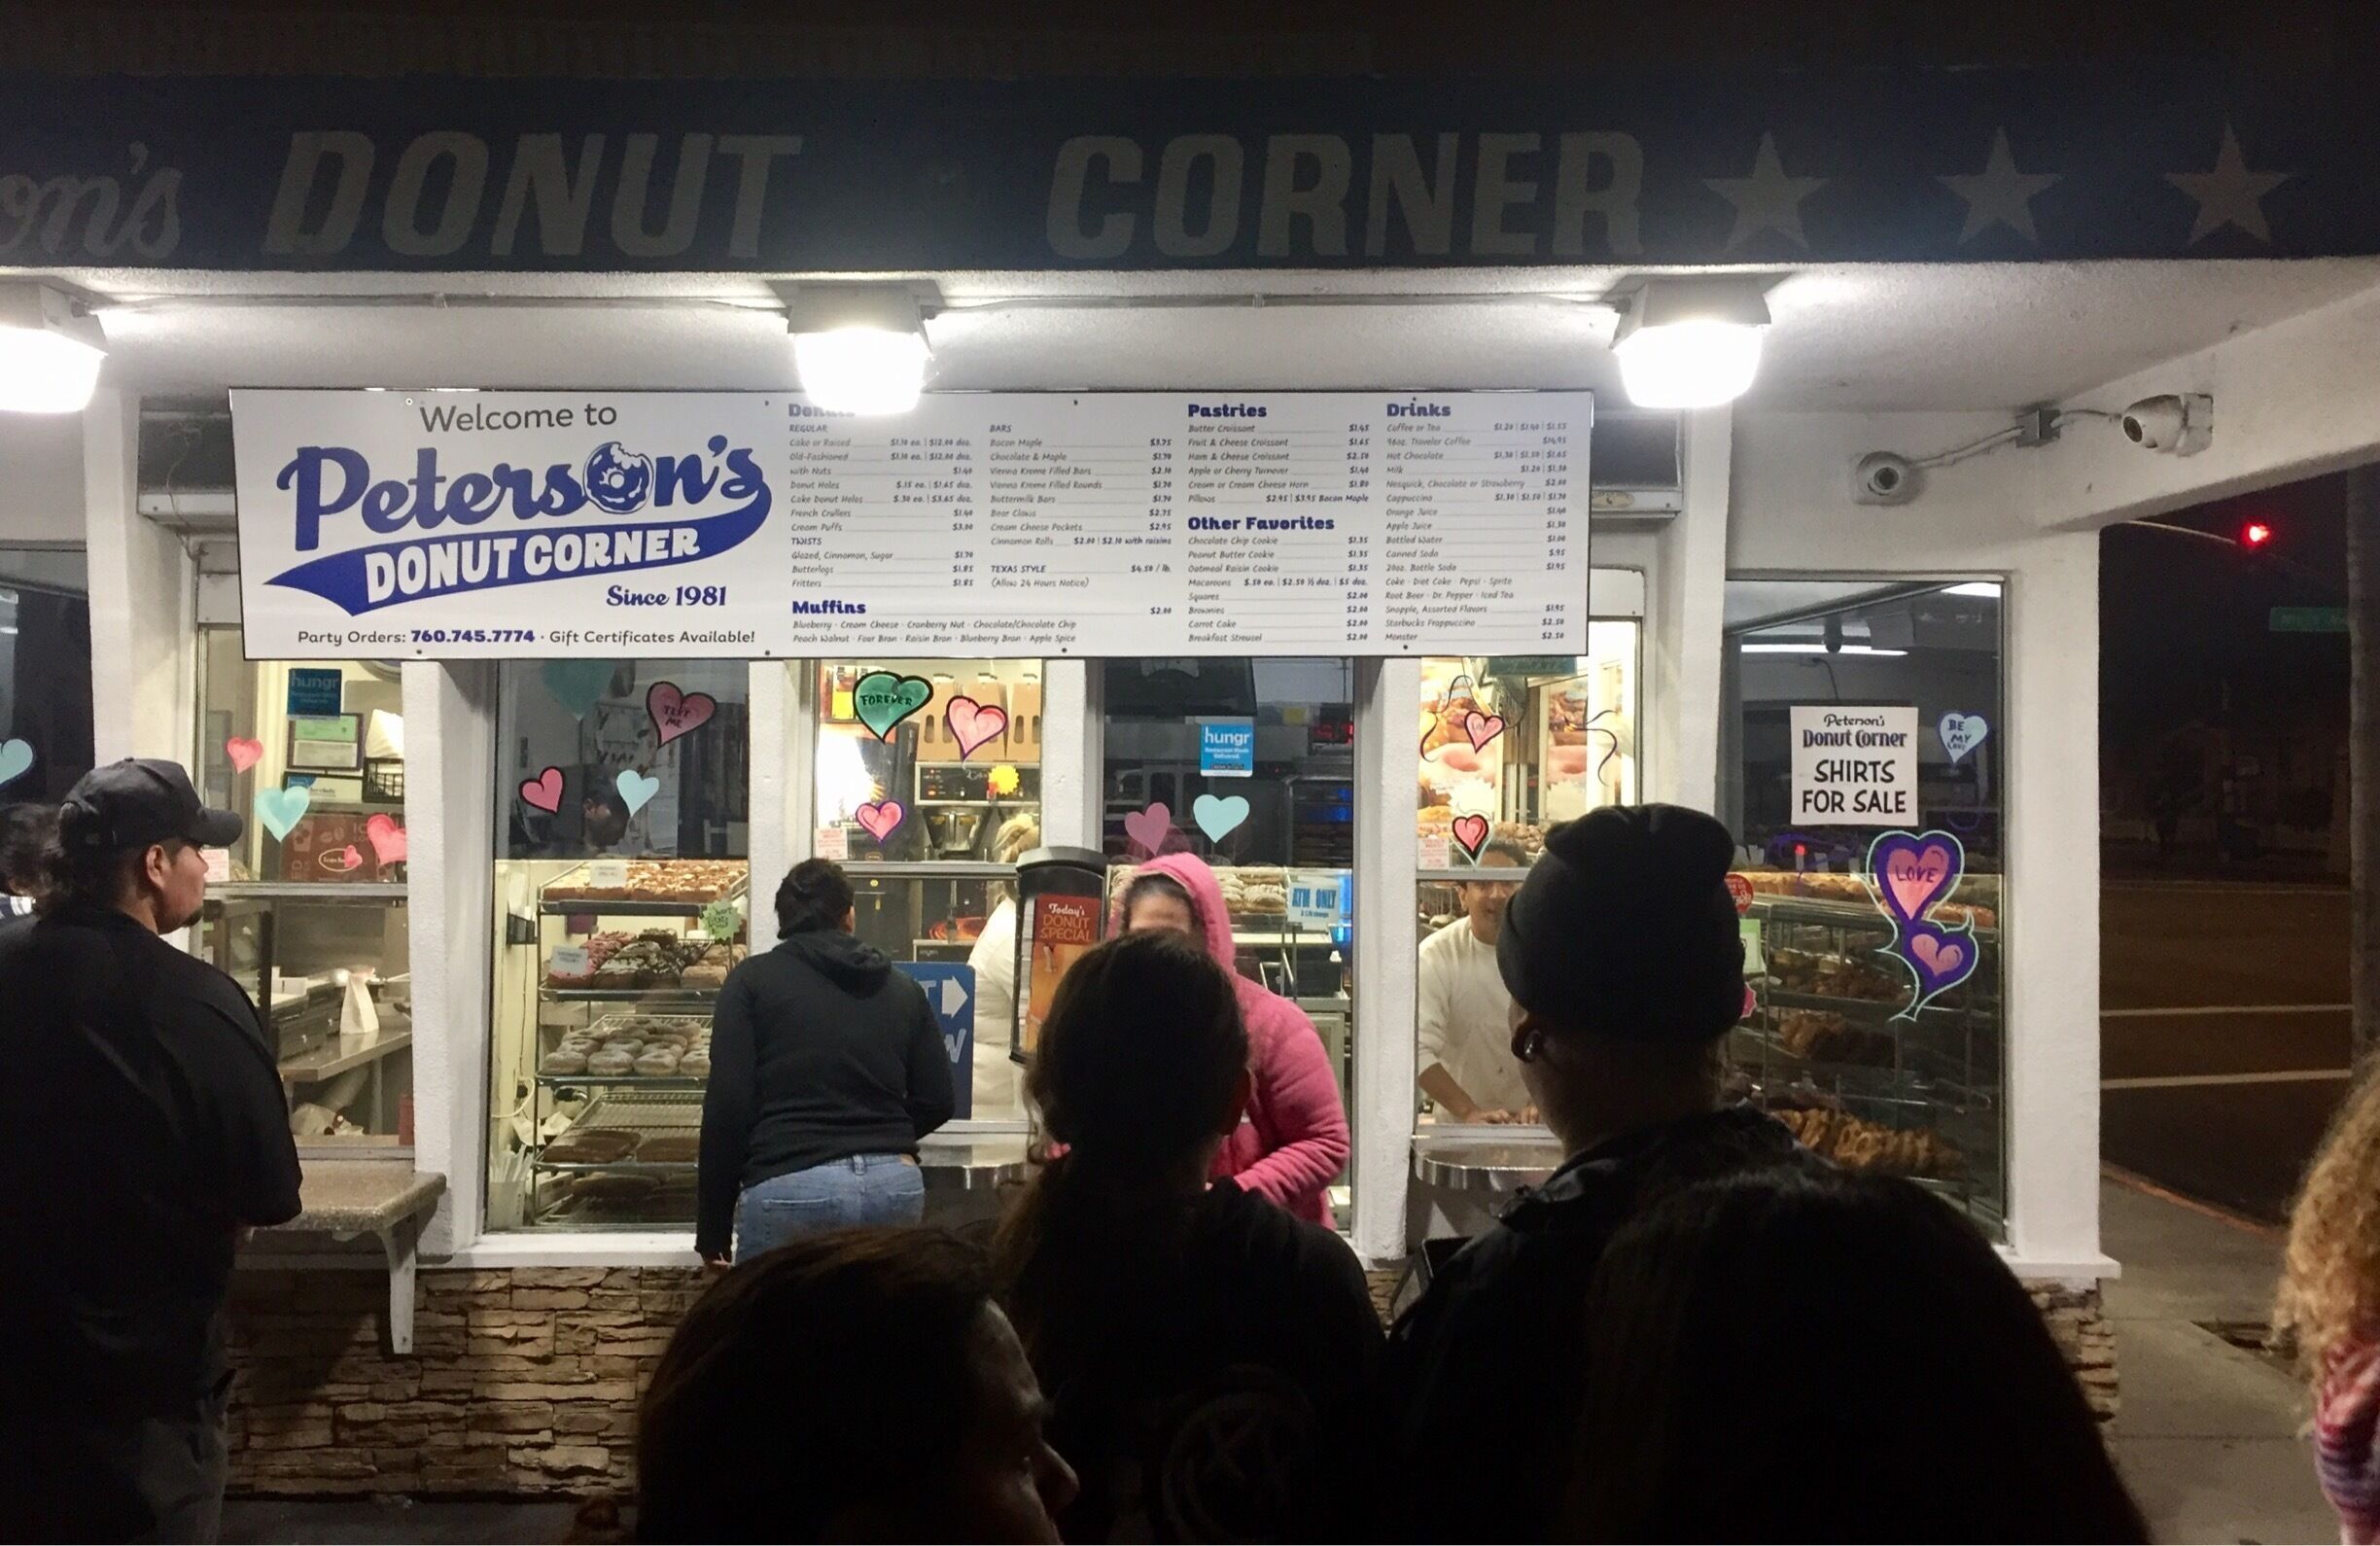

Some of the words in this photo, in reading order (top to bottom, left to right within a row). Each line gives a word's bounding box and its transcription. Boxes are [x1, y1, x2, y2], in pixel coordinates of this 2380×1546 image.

[265, 130, 802, 258] DONUT
[1046, 131, 1645, 259] CORNER
[1188, 404, 1267, 417] Pastries
[1387, 403, 1451, 417] Drinks
[419, 404, 574, 433] Welcome
[584, 404, 617, 426] to
[789, 424, 827, 433] REGULAR
[990, 424, 1011, 433] BARS
[1217, 422, 1255, 433] Croissant
[1386, 422, 1414, 433] Coffee
[1427, 423, 1441, 432] Tea
[1219, 438, 1248, 447] Cheese
[1410, 437, 1442, 446] Traveler
[1444, 436, 1471, 446] Coffee
[1188, 452, 1208, 461] Ham
[1220, 451, 1249, 461] Cheese
[1252, 452, 1289, 461] Croissant
[1403, 450, 1444, 460] Chocolate
[1188, 466, 1211, 476] Apple
[1225, 466, 1252, 477] Cherry
[1386, 466, 1403, 474] Milk
[1188, 480, 1214, 489] Cream
[1229, 480, 1255, 489] Cream
[1258, 479, 1286, 489] Cheese
[1386, 494, 1433, 504] Cappuccino
[790, 509, 818, 517] French
[822, 509, 851, 517] Crullers
[1385, 509, 1415, 518] Orange
[1417, 508, 1438, 516] Juice
[821, 522, 842, 532] Puffs
[1020, 522, 1049, 531] Cheese
[1188, 517, 1241, 530] Other
[1246, 516, 1334, 530] Favorites
[1386, 521, 1409, 532] Apple
[1188, 536, 1228, 545] Chocolate
[1231, 536, 1249, 546] Chip
[1252, 536, 1278, 545] Cookie
[1385, 535, 1417, 545] Bottled
[1418, 536, 1443, 545] Water
[791, 551, 821, 561] Glazed,
[823, 551, 867, 561] Cinnamon,
[870, 552, 892, 562] Sugar
[1188, 550, 1216, 559] Peanut
[1219, 550, 1245, 559] Butter
[1248, 549, 1275, 559] Cookie
[1385, 549, 1418, 558] Canned
[1419, 548, 1438, 558] Soda
[365, 538, 517, 604] DONUT
[524, 527, 700, 576] CORNER
[791, 564, 833, 576] Butterlogs
[1188, 564, 1223, 573] Oatmeal
[1225, 564, 1249, 573] Raisin
[1252, 564, 1278, 573] Cookie
[1410, 562, 1435, 572] Bottle
[1437, 563, 1456, 572] Soda
[991, 577, 1017, 588] (Allow
[1020, 579, 1031, 588] 24
[1059, 577, 1089, 588] Notice)
[1188, 579, 1231, 587] Macaroons
[1385, 577, 1405, 586] Coke
[1432, 577, 1452, 585] Coke
[1459, 578, 1481, 587] Pepsi
[1488, 577, 1512, 587] Sprite
[607, 584, 670, 607] Since
[676, 585, 727, 607] 1981
[1188, 592, 1219, 603] Squares
[1446, 591, 1473, 601] Pepper
[792, 600, 866, 614] Muffins
[1385, 605, 1418, 615] Snapple,
[793, 620, 832, 631] Blueberry
[840, 620, 866, 629] Cream
[870, 620, 899, 629] Cheese
[907, 619, 947, 631] Cranberry
[973, 619, 1055, 629] Chocolate/Chocolate
[1058, 619, 1076, 630] Chip
[1216, 619, 1237, 628] Cake
[1385, 617, 1424, 627] Starbucks
[1427, 618, 1475, 628] Frappuccino
[298, 630, 342, 647] Party
[347, 630, 406, 644] Orders:
[410, 630, 535, 643] 760.745.7774
[549, 630, 579, 646] Gift
[589, 630, 675, 646] Certificates
[680, 630, 755, 643] Available!
[793, 634, 818, 643] Peach
[821, 634, 850, 643] Walnut
[905, 634, 929, 643] Raisin
[932, 634, 952, 643] Bran
[960, 634, 998, 645] Blueberry
[1030, 634, 1052, 645] Apple
[1055, 634, 1076, 644] Spice
[1188, 633, 1227, 642] Breakfast
[1230, 633, 1262, 642] Streusel
[859, 694, 913, 706] FOREVER
[665, 717, 682, 728] ME
[1824, 714, 1885, 727] Peterson's
[1947, 720, 1965, 731] BE
[1205, 725, 1251, 747] hungr
[1802, 729, 1852, 748] Donut
[1855, 730, 1908, 749] Corner
[1951, 734, 1972, 744] MY
[1814, 759, 1895, 784] SHIRTS
[1802, 791, 1845, 813] FOR
[1852, 790, 1907, 814] SALE
[1896, 865, 1938, 883] LOVE
[1316, 889, 1337, 909] ONLY
[1049, 903, 1085, 918] Today's
[1043, 914, 1090, 929] DONUT
[1040, 927, 1091, 942] SPECIAL
